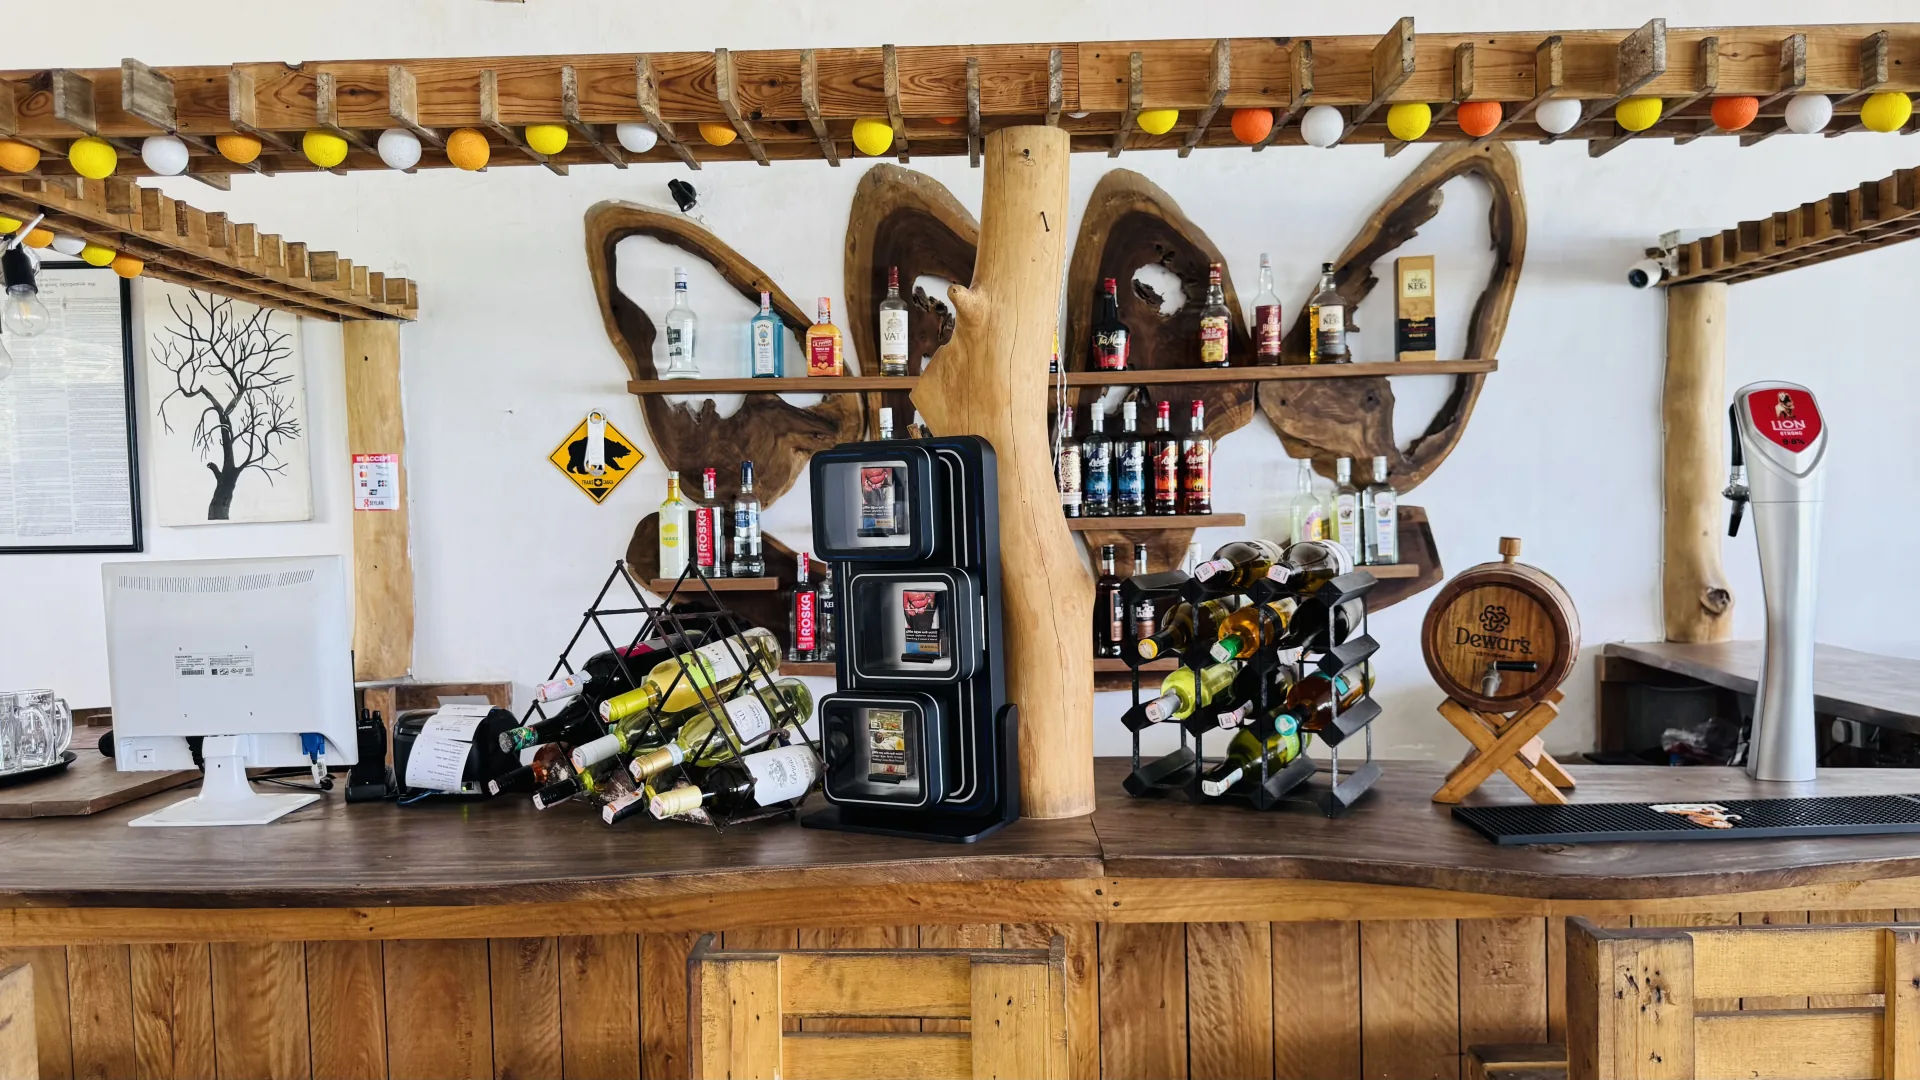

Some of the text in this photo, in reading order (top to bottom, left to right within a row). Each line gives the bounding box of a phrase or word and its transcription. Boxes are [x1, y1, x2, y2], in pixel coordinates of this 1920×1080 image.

[1408, 282, 1427, 290] KEG
[1771, 420, 1806, 430] LION
[698, 510, 707, 552] ROSKA
[801, 595, 811, 636] ROSKA
